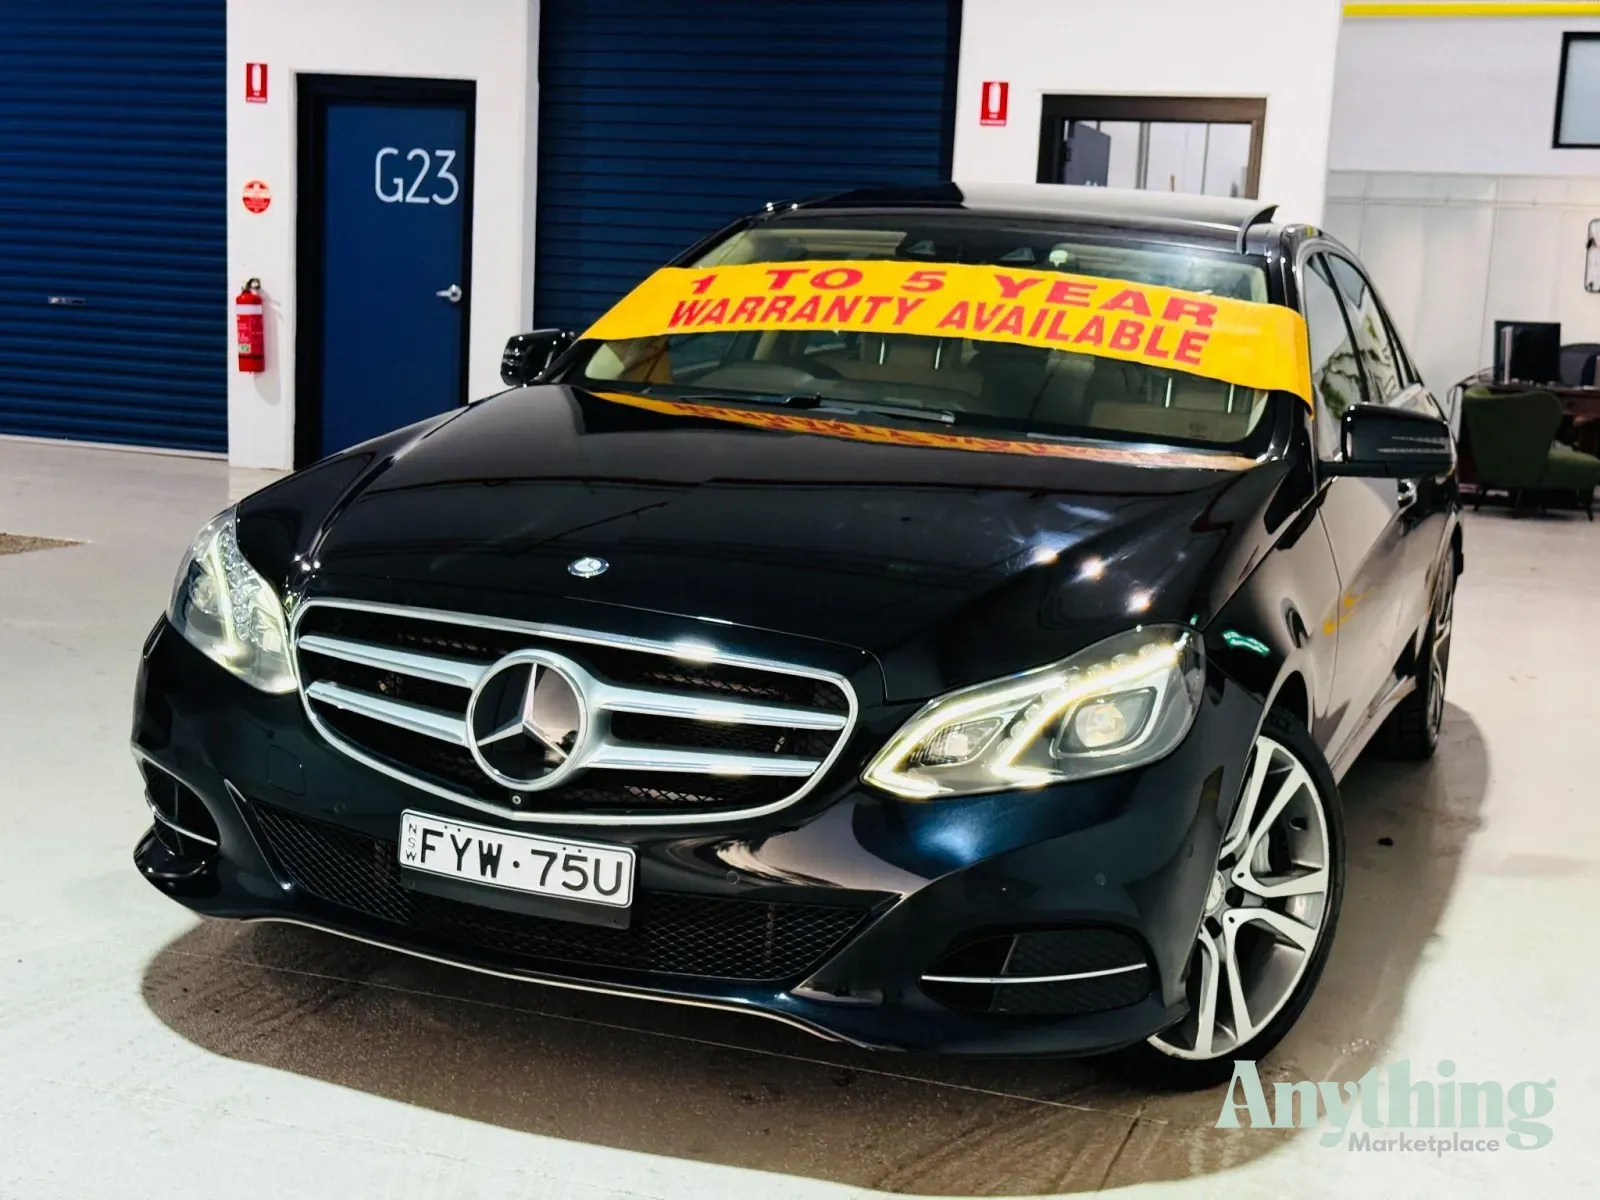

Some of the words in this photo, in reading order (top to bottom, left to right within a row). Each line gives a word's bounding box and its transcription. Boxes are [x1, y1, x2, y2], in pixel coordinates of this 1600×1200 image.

[374, 147, 460, 205] G23
[691, 274, 718, 295] 1
[765, 268, 864, 291] TO
[900, 271, 948, 293] 5
[994, 274, 1219, 329] YEAR
[667, 294, 926, 329] WARRANTY
[935, 300, 1211, 366] AVAILABLE
[405, 823, 418, 863] NSW
